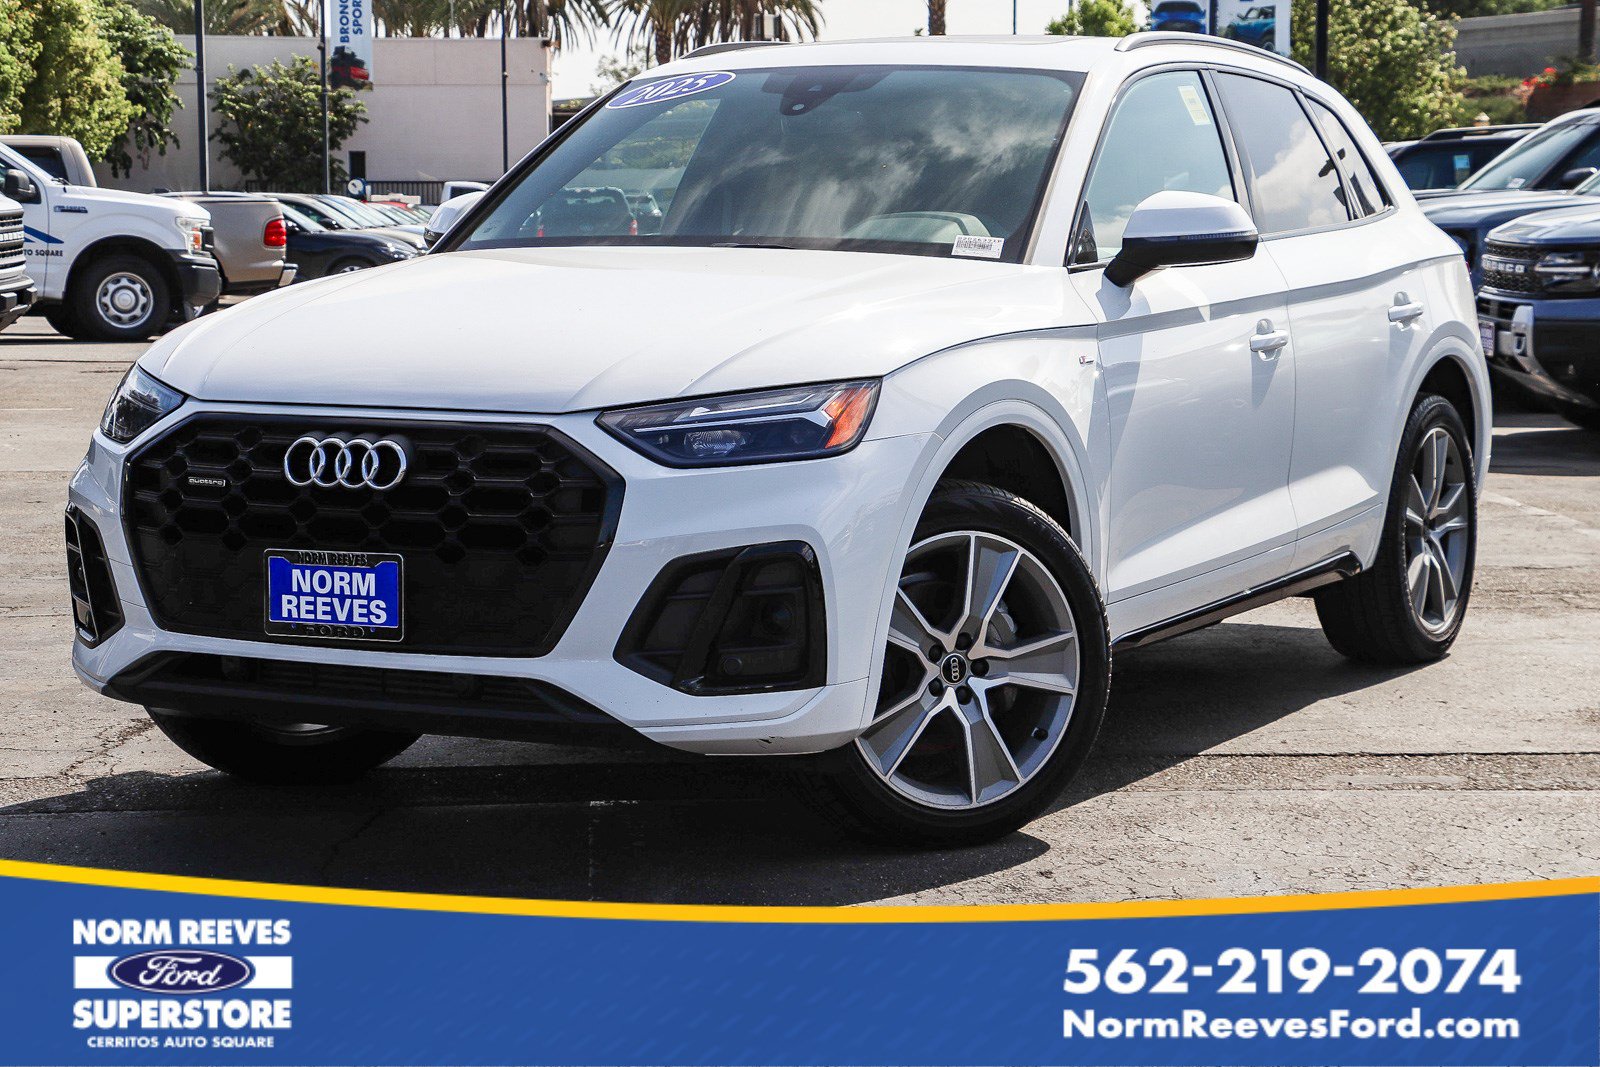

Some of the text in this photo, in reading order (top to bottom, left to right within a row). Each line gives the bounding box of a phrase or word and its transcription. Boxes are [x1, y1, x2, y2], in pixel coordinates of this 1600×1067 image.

[620, 73, 719, 106] 2025
[35, 249, 63, 257] SQUARE
[188, 477, 226, 487] quattro
[298, 551, 368, 566] NORM REEVES
[291, 569, 376, 597] NORM
[281, 594, 387, 624] REEVES
